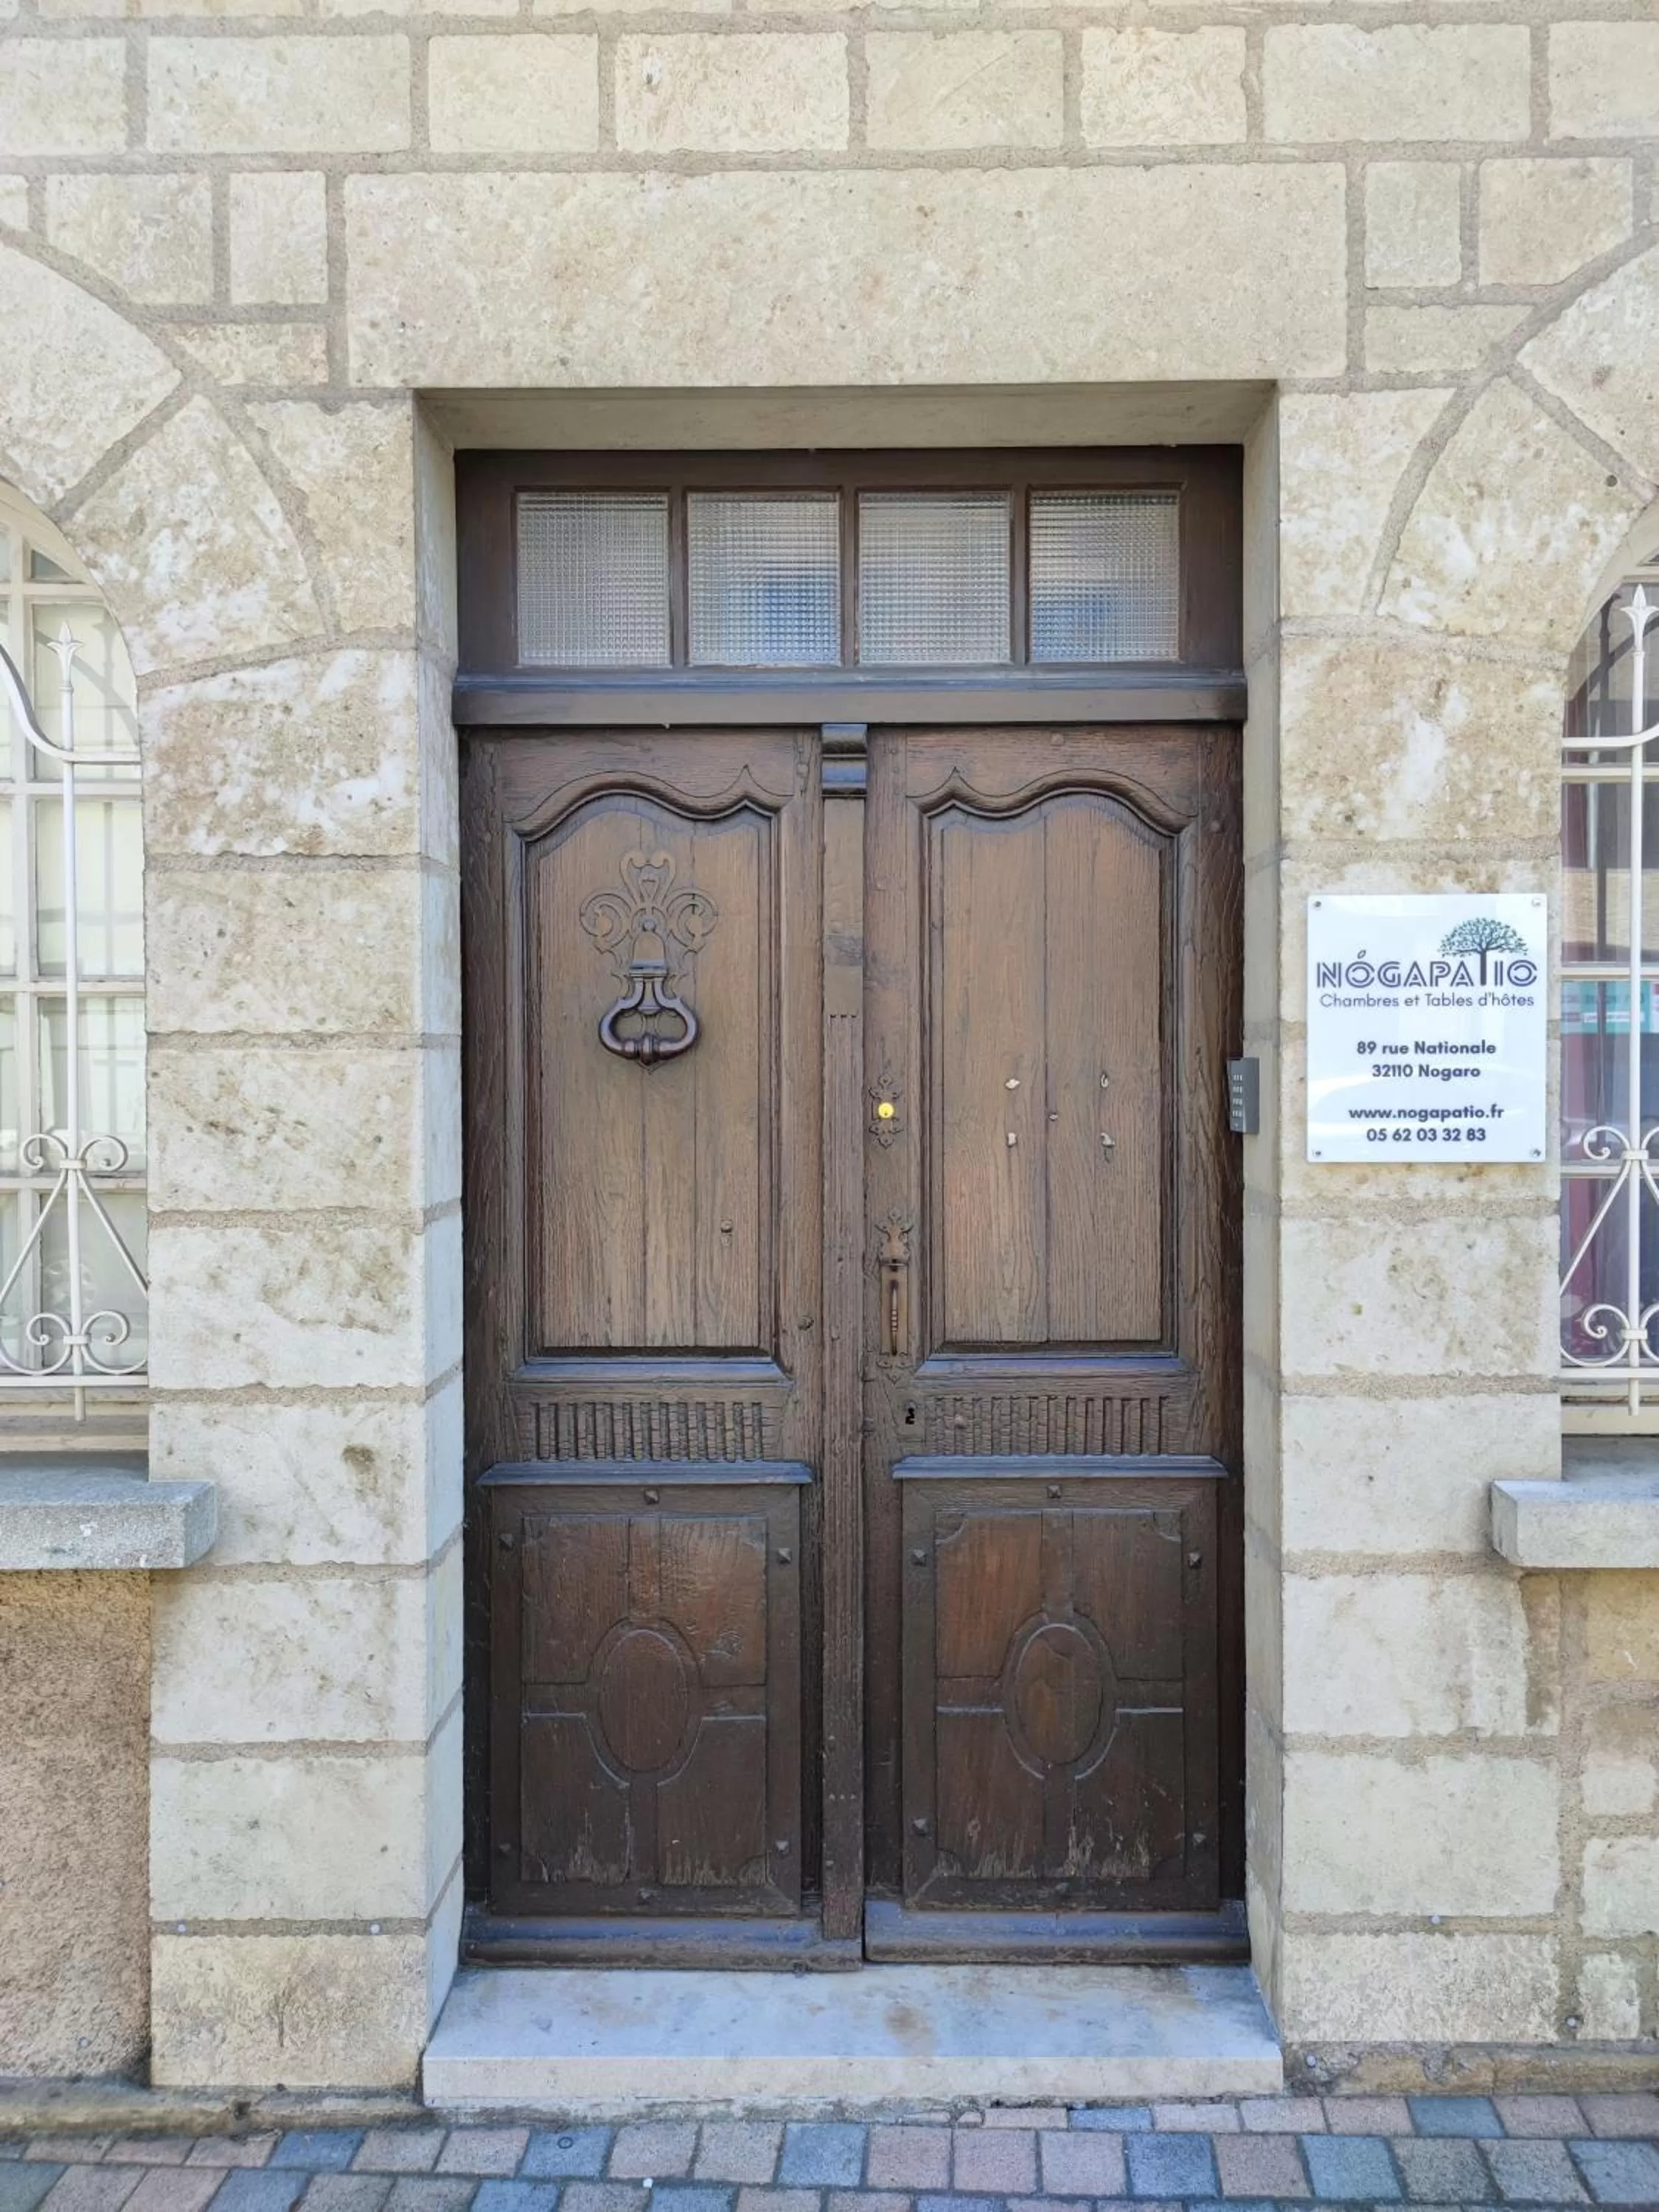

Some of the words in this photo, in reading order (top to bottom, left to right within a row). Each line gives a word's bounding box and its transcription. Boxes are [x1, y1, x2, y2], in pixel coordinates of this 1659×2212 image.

[1320, 993, 1399, 1007] Chambres
[1404, 995, 1420, 1007] et
[1425, 992, 1473, 1007] Tables
[1478, 992, 1534, 1007] d'hôtes
[1357, 1040, 1377, 1054] 89
[1382, 1044, 1409, 1054] rue
[1414, 1040, 1497, 1054] Nationale
[1372, 1064, 1413, 1077] 32110
[1419, 1064, 1481, 1082] Nogaro
[1349, 1104, 1505, 1122] www.nogapatio.fr
[1366, 1128, 1387, 1142] 05
[1392, 1128, 1411, 1141] 62
[1416, 1128, 1437, 1141] 03
[1442, 1127, 1461, 1141] 32
[1467, 1127, 1486, 1141] 83
